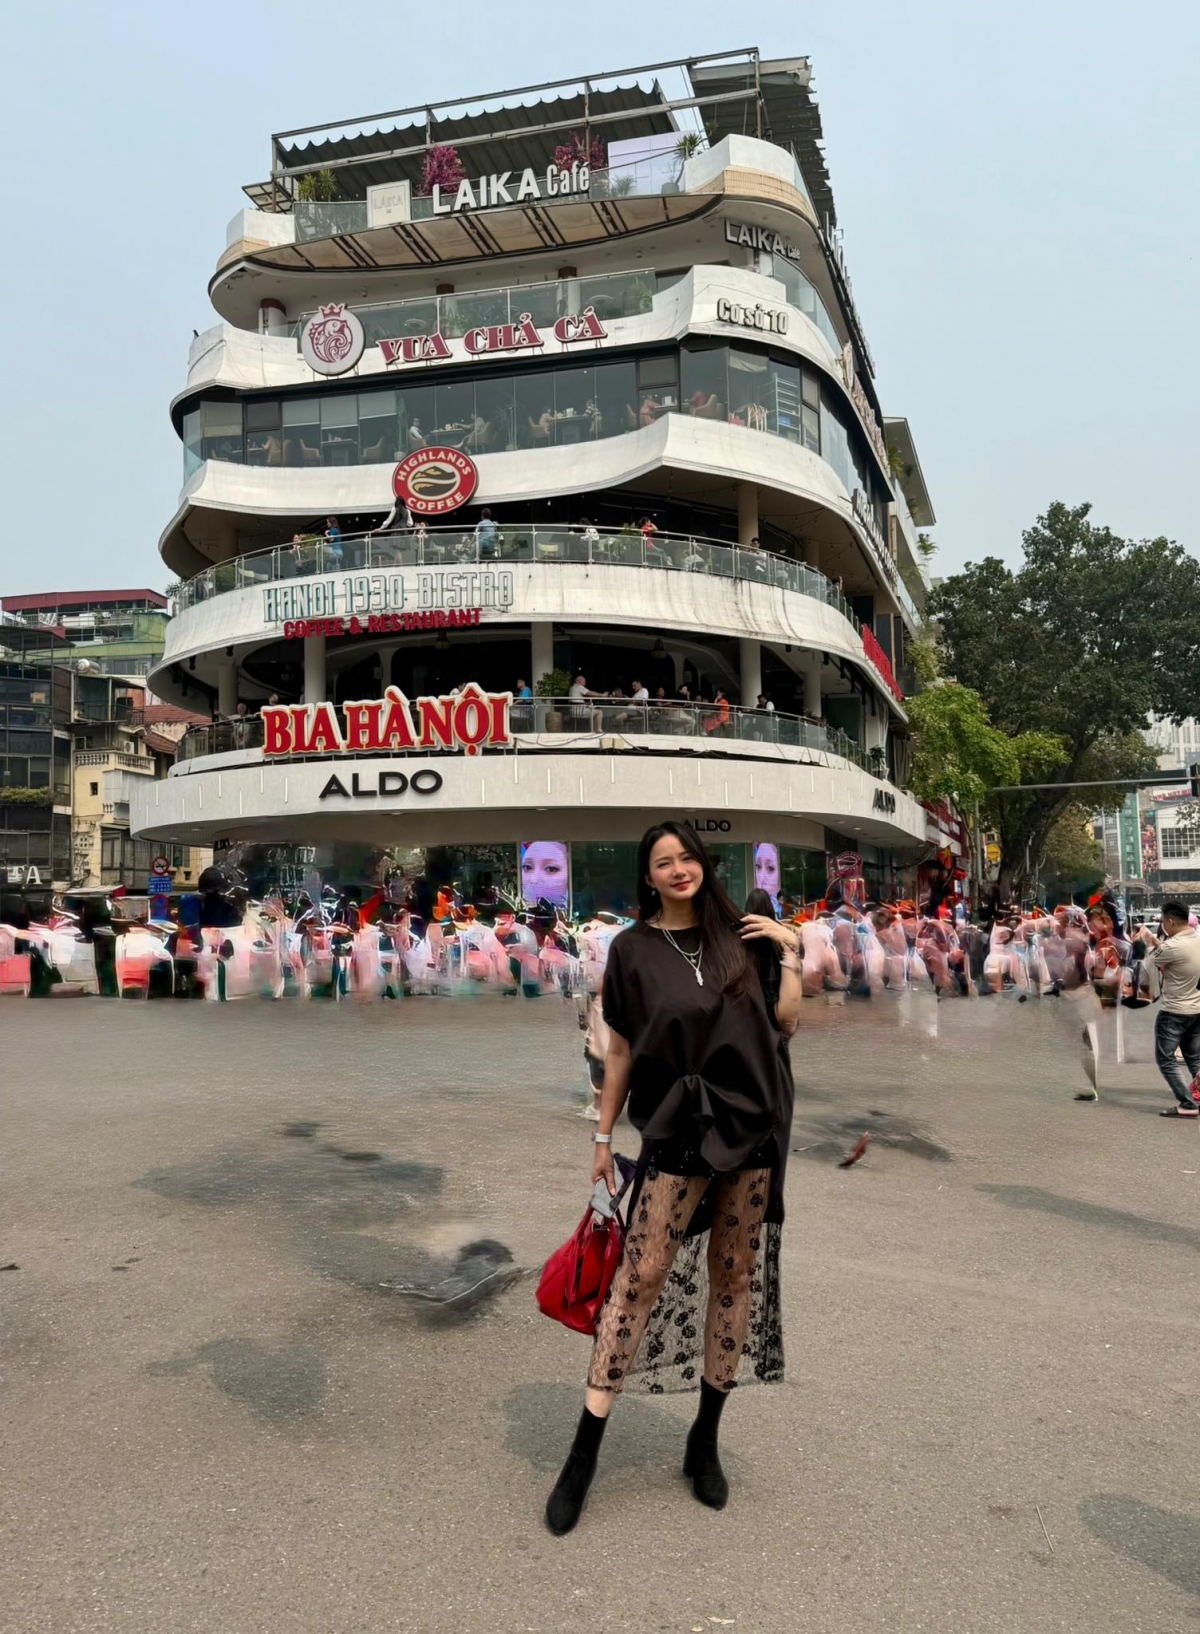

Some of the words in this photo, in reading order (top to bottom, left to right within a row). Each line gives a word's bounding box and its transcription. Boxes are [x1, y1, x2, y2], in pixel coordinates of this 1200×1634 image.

[433, 168, 541, 213] LAIKA
[547, 160, 590, 196] Café
[725, 219, 786, 256] LAIKA
[376, 331, 453, 364] VUA
[463, 312, 544, 354] CHẢ
[554, 305, 608, 343] CÁ
[769, 310, 789, 334] 10
[397, 451, 471, 481] HIGHLANDS
[407, 491, 464, 511] COFFEE
[262, 580, 336, 622] HANOI
[343, 574, 405, 613] 1930
[417, 571, 514, 609] BISTRO
[283, 617, 346, 639] COFFEE
[350, 616, 364, 635] &
[368, 607, 483, 633] RESTAURANT
[261, 703, 345, 756] BIA
[318, 769, 443, 798] ALDO
